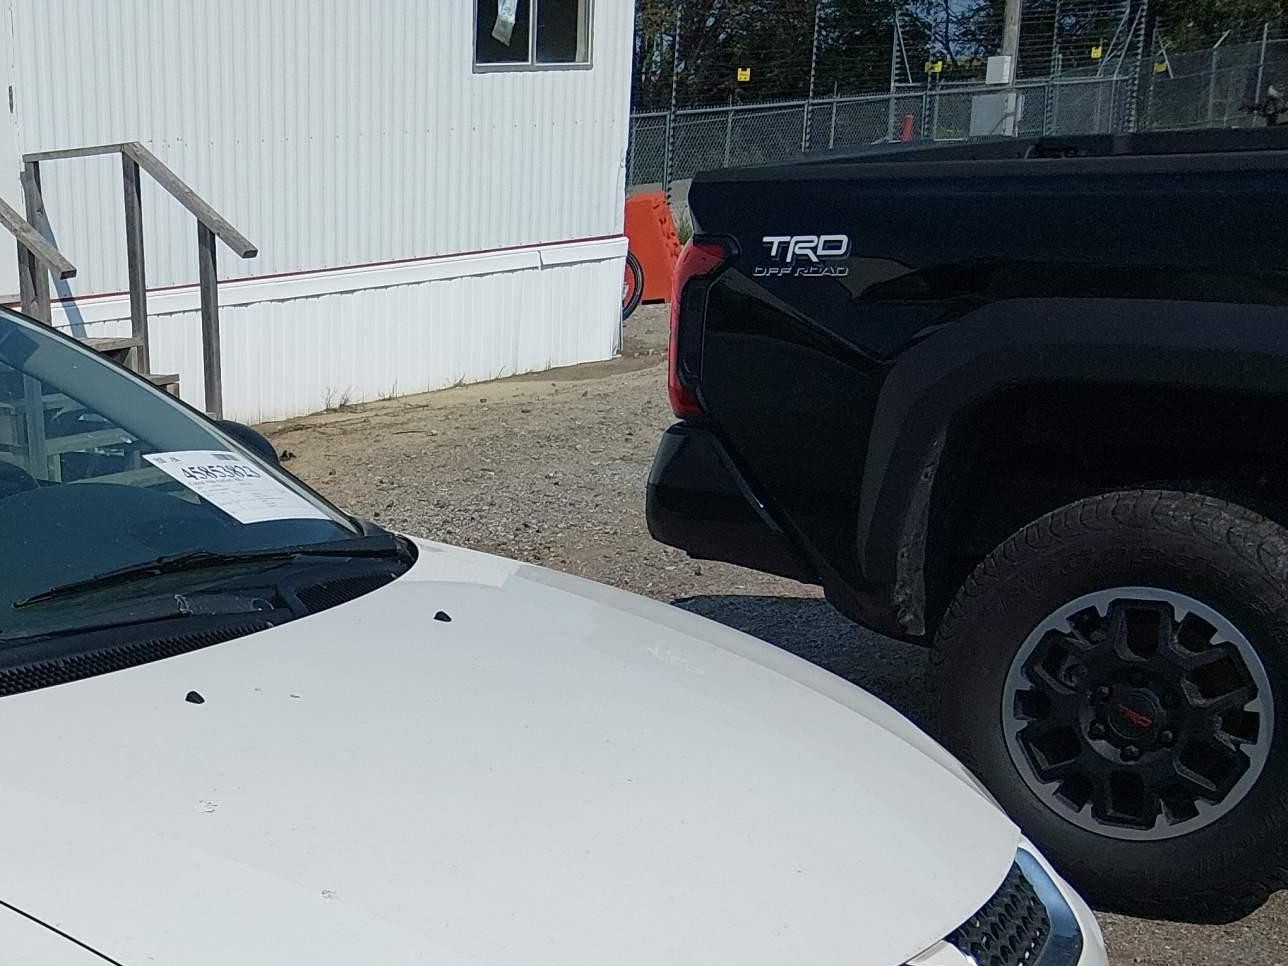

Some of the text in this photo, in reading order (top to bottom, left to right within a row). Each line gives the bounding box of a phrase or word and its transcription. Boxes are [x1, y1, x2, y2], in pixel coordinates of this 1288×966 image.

[762, 234, 849, 262] TRD
[753, 266, 849, 277] OFF ROAD
[181, 465, 261, 480] 45853823
